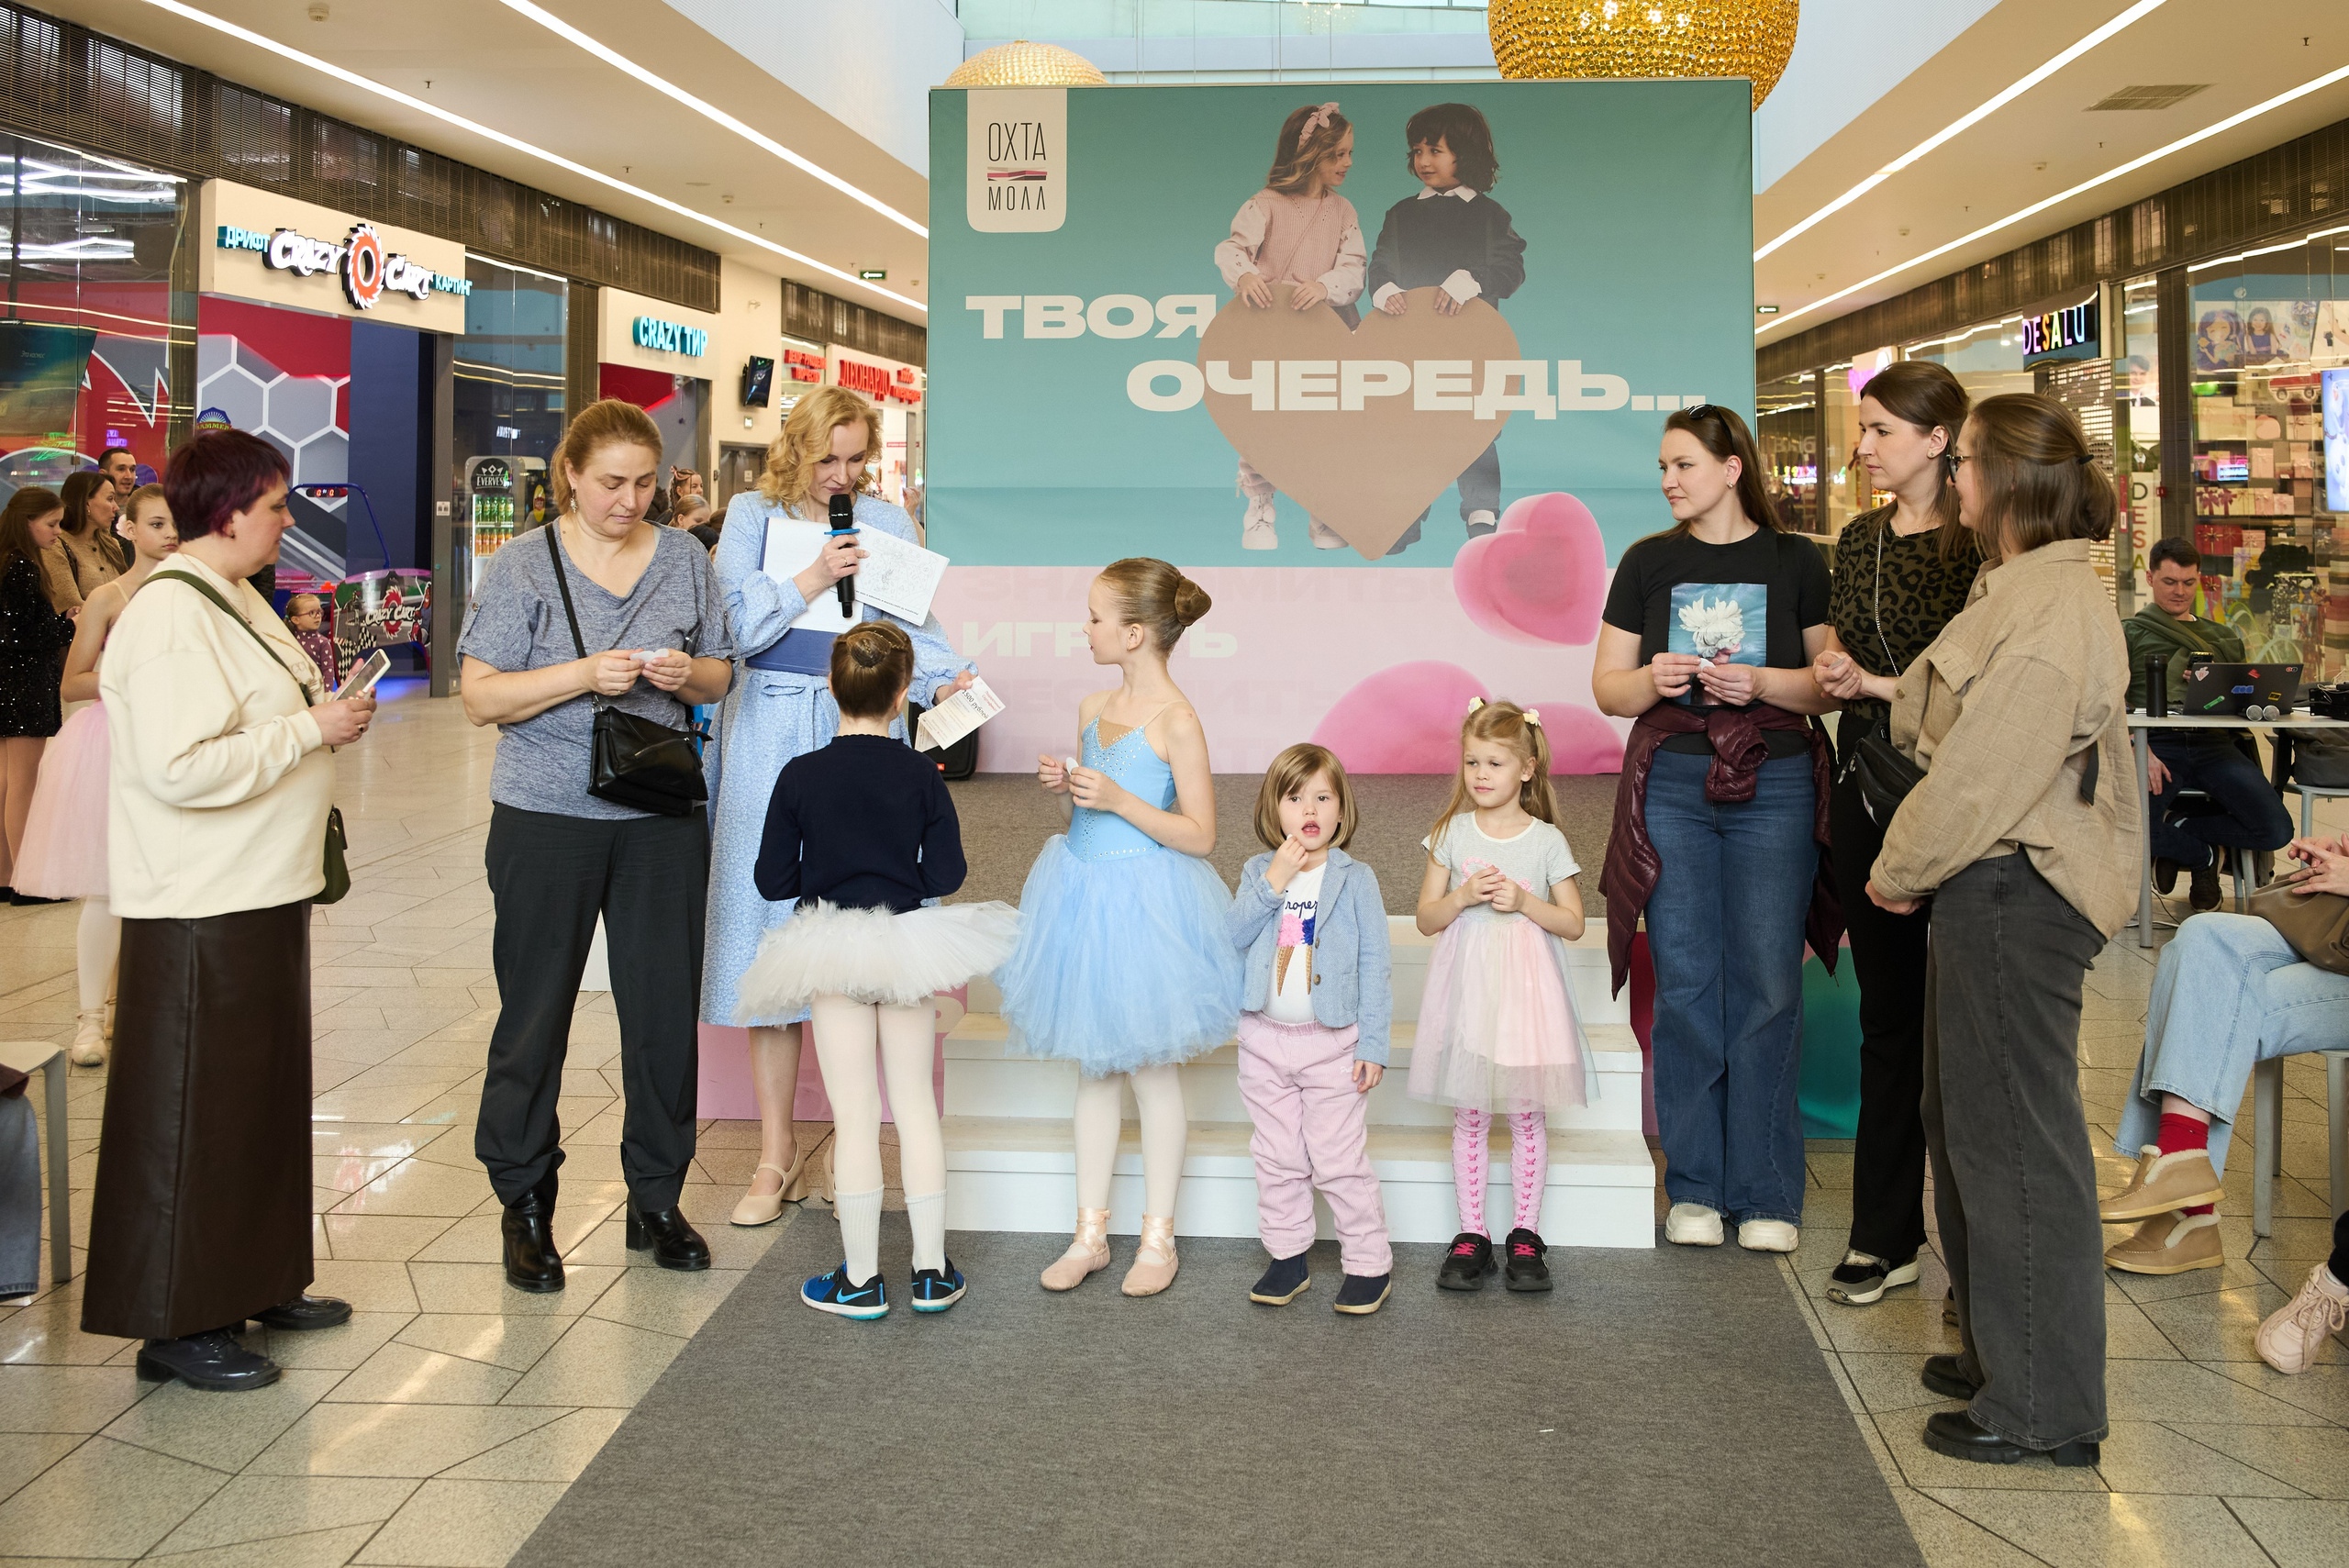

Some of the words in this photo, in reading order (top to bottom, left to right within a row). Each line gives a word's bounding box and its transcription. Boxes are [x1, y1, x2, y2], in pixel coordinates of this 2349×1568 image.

[987, 122, 1047, 162] ОХТА
[987, 185, 1046, 211] МОЛЛ
[224, 226, 271, 253] ДРИФТ
[270, 229, 348, 276] CRAZY
[385, 254, 436, 300] CART
[435, 273, 473, 296] КАРТИНГ
[965, 294, 1217, 339] ТВОЯ
[2021, 305, 2085, 355] DESALU
[639, 316, 682, 352] CRAZY
[684, 326, 708, 357] ТИР
[839, 360, 891, 399] ЛЕОНАРДО
[1126, 360, 1707, 420] ОЧЕРЕДЬ...
[476, 476, 506, 486] EVERVES
[365, 607, 393, 627] CRAZY
[395, 606, 416, 621] CART
[963, 621, 1238, 658] ИГРЬ
